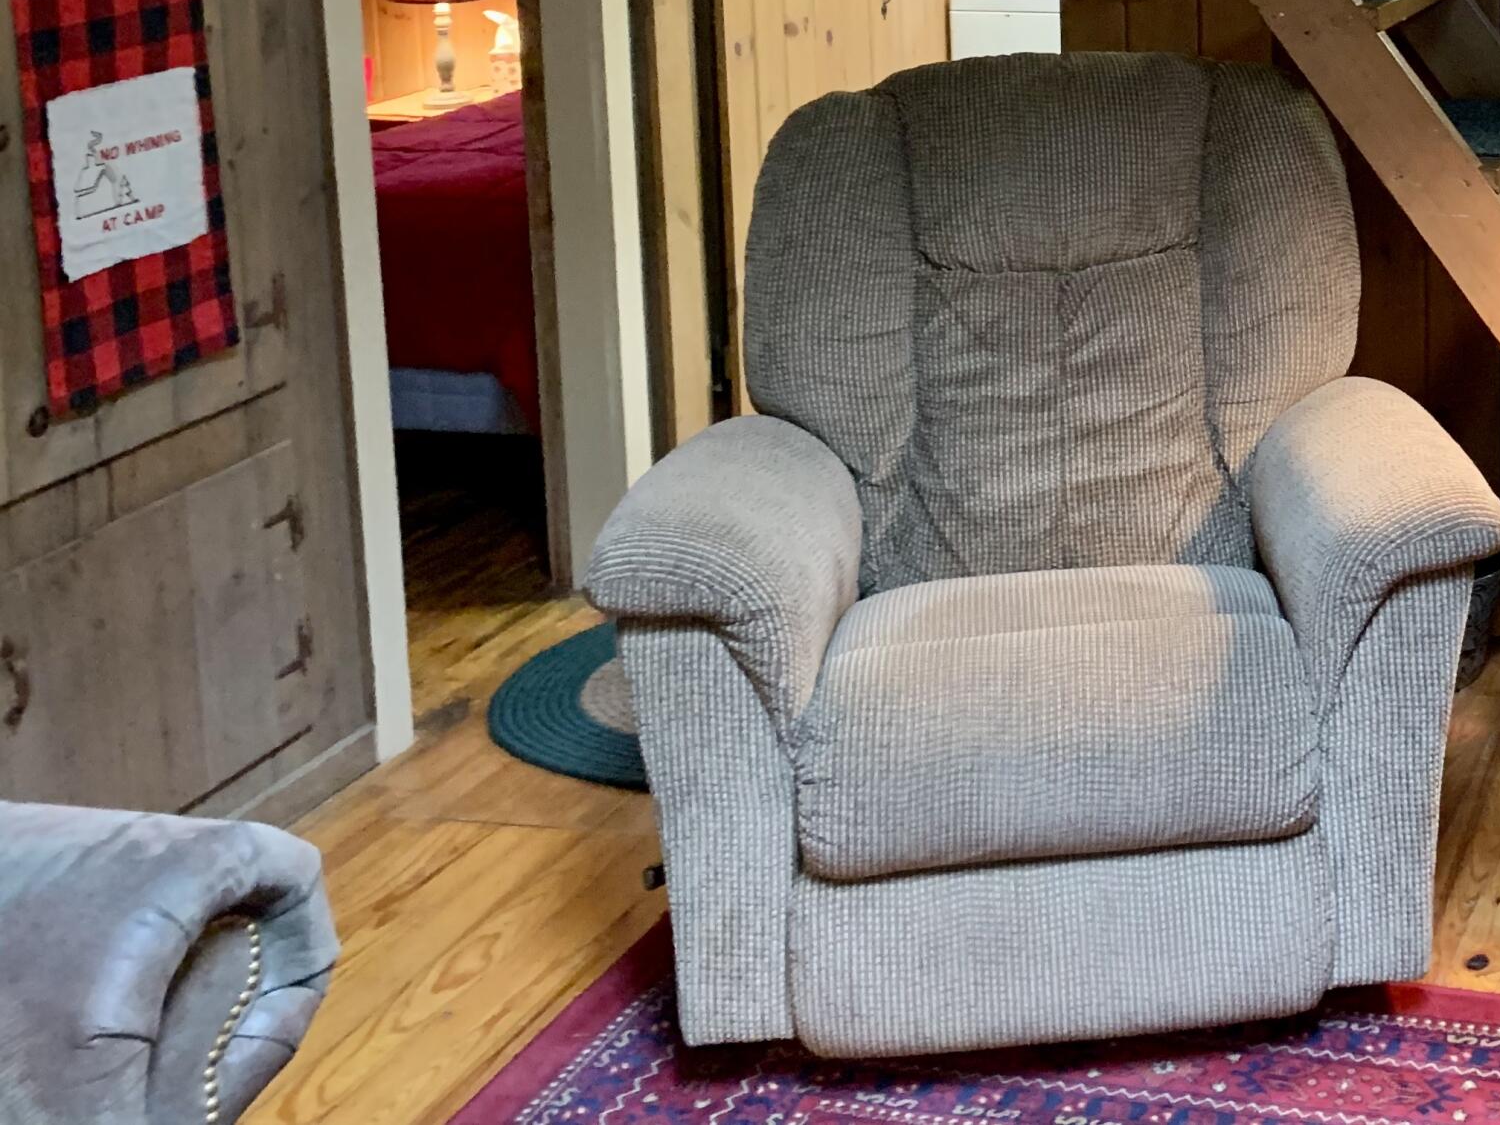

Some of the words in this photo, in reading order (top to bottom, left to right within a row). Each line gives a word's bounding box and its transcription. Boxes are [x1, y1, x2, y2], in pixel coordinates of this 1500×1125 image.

[100, 146, 120, 161] NO
[125, 130, 182, 156] WHINING
[102, 217, 118, 232] AT
[123, 204, 165, 226] CAMP
